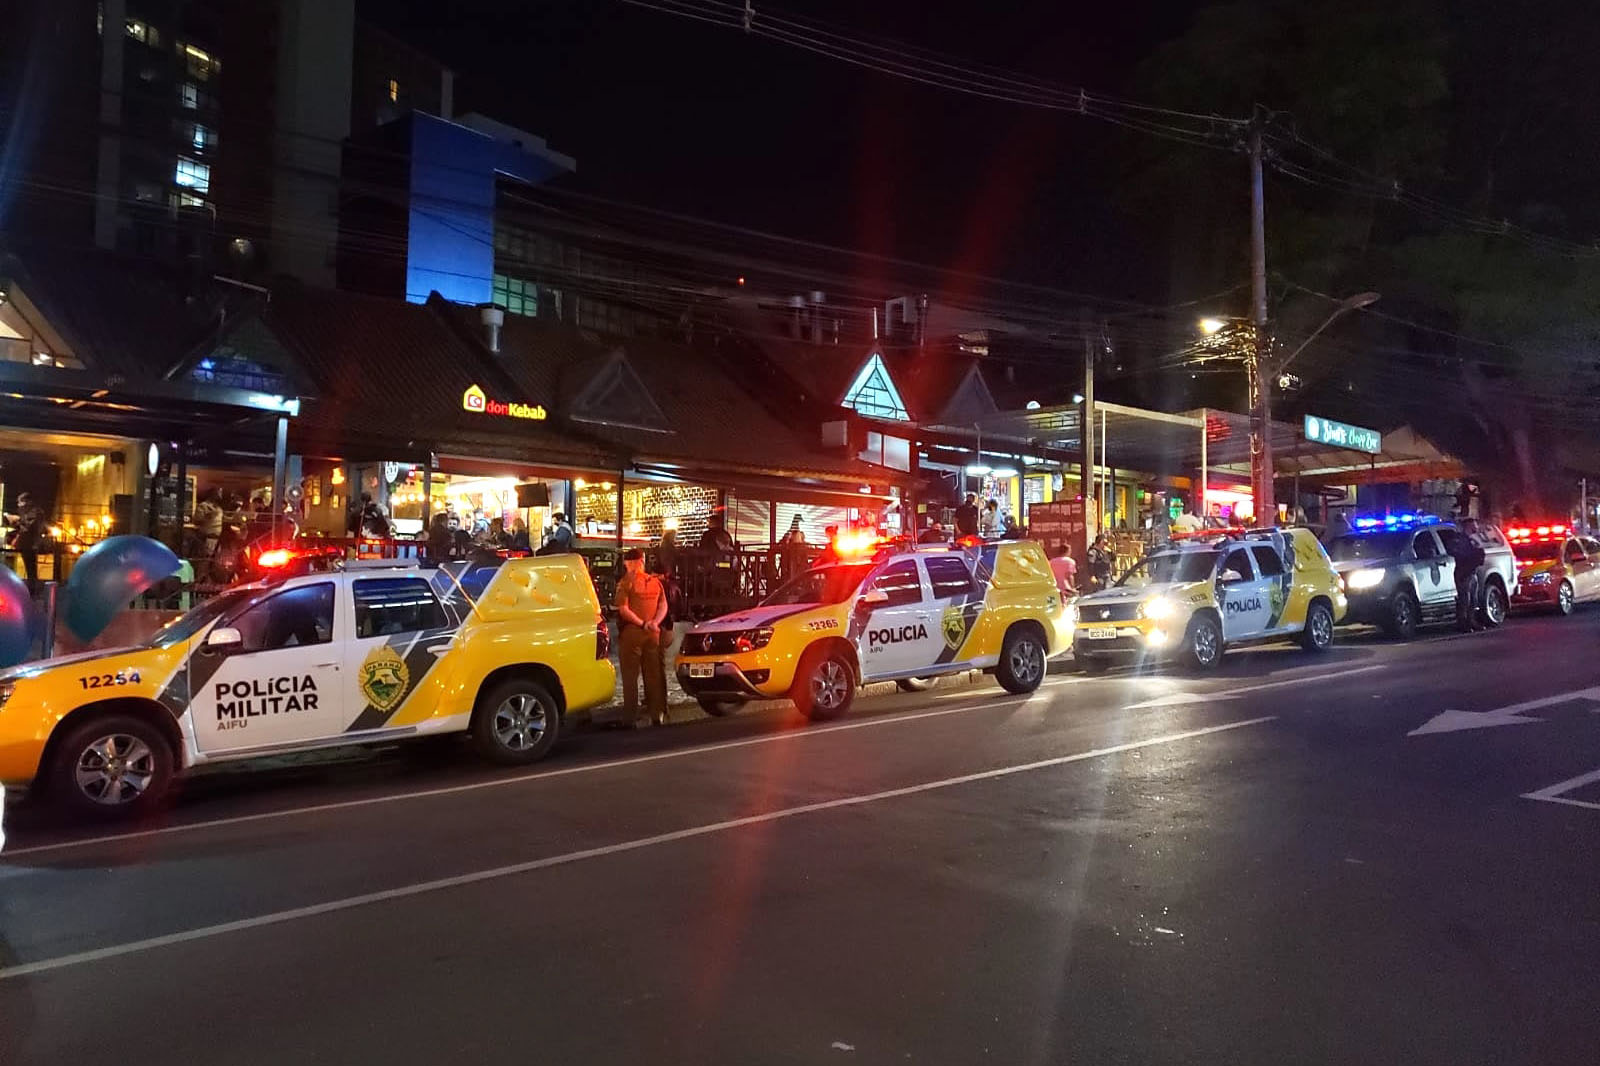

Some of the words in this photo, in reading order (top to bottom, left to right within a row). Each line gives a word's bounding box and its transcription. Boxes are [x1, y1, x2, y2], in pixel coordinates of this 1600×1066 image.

[79, 672, 142, 690] 12254
[216, 693, 319, 721] MILITAR
[216, 719, 249, 732] AIFU
